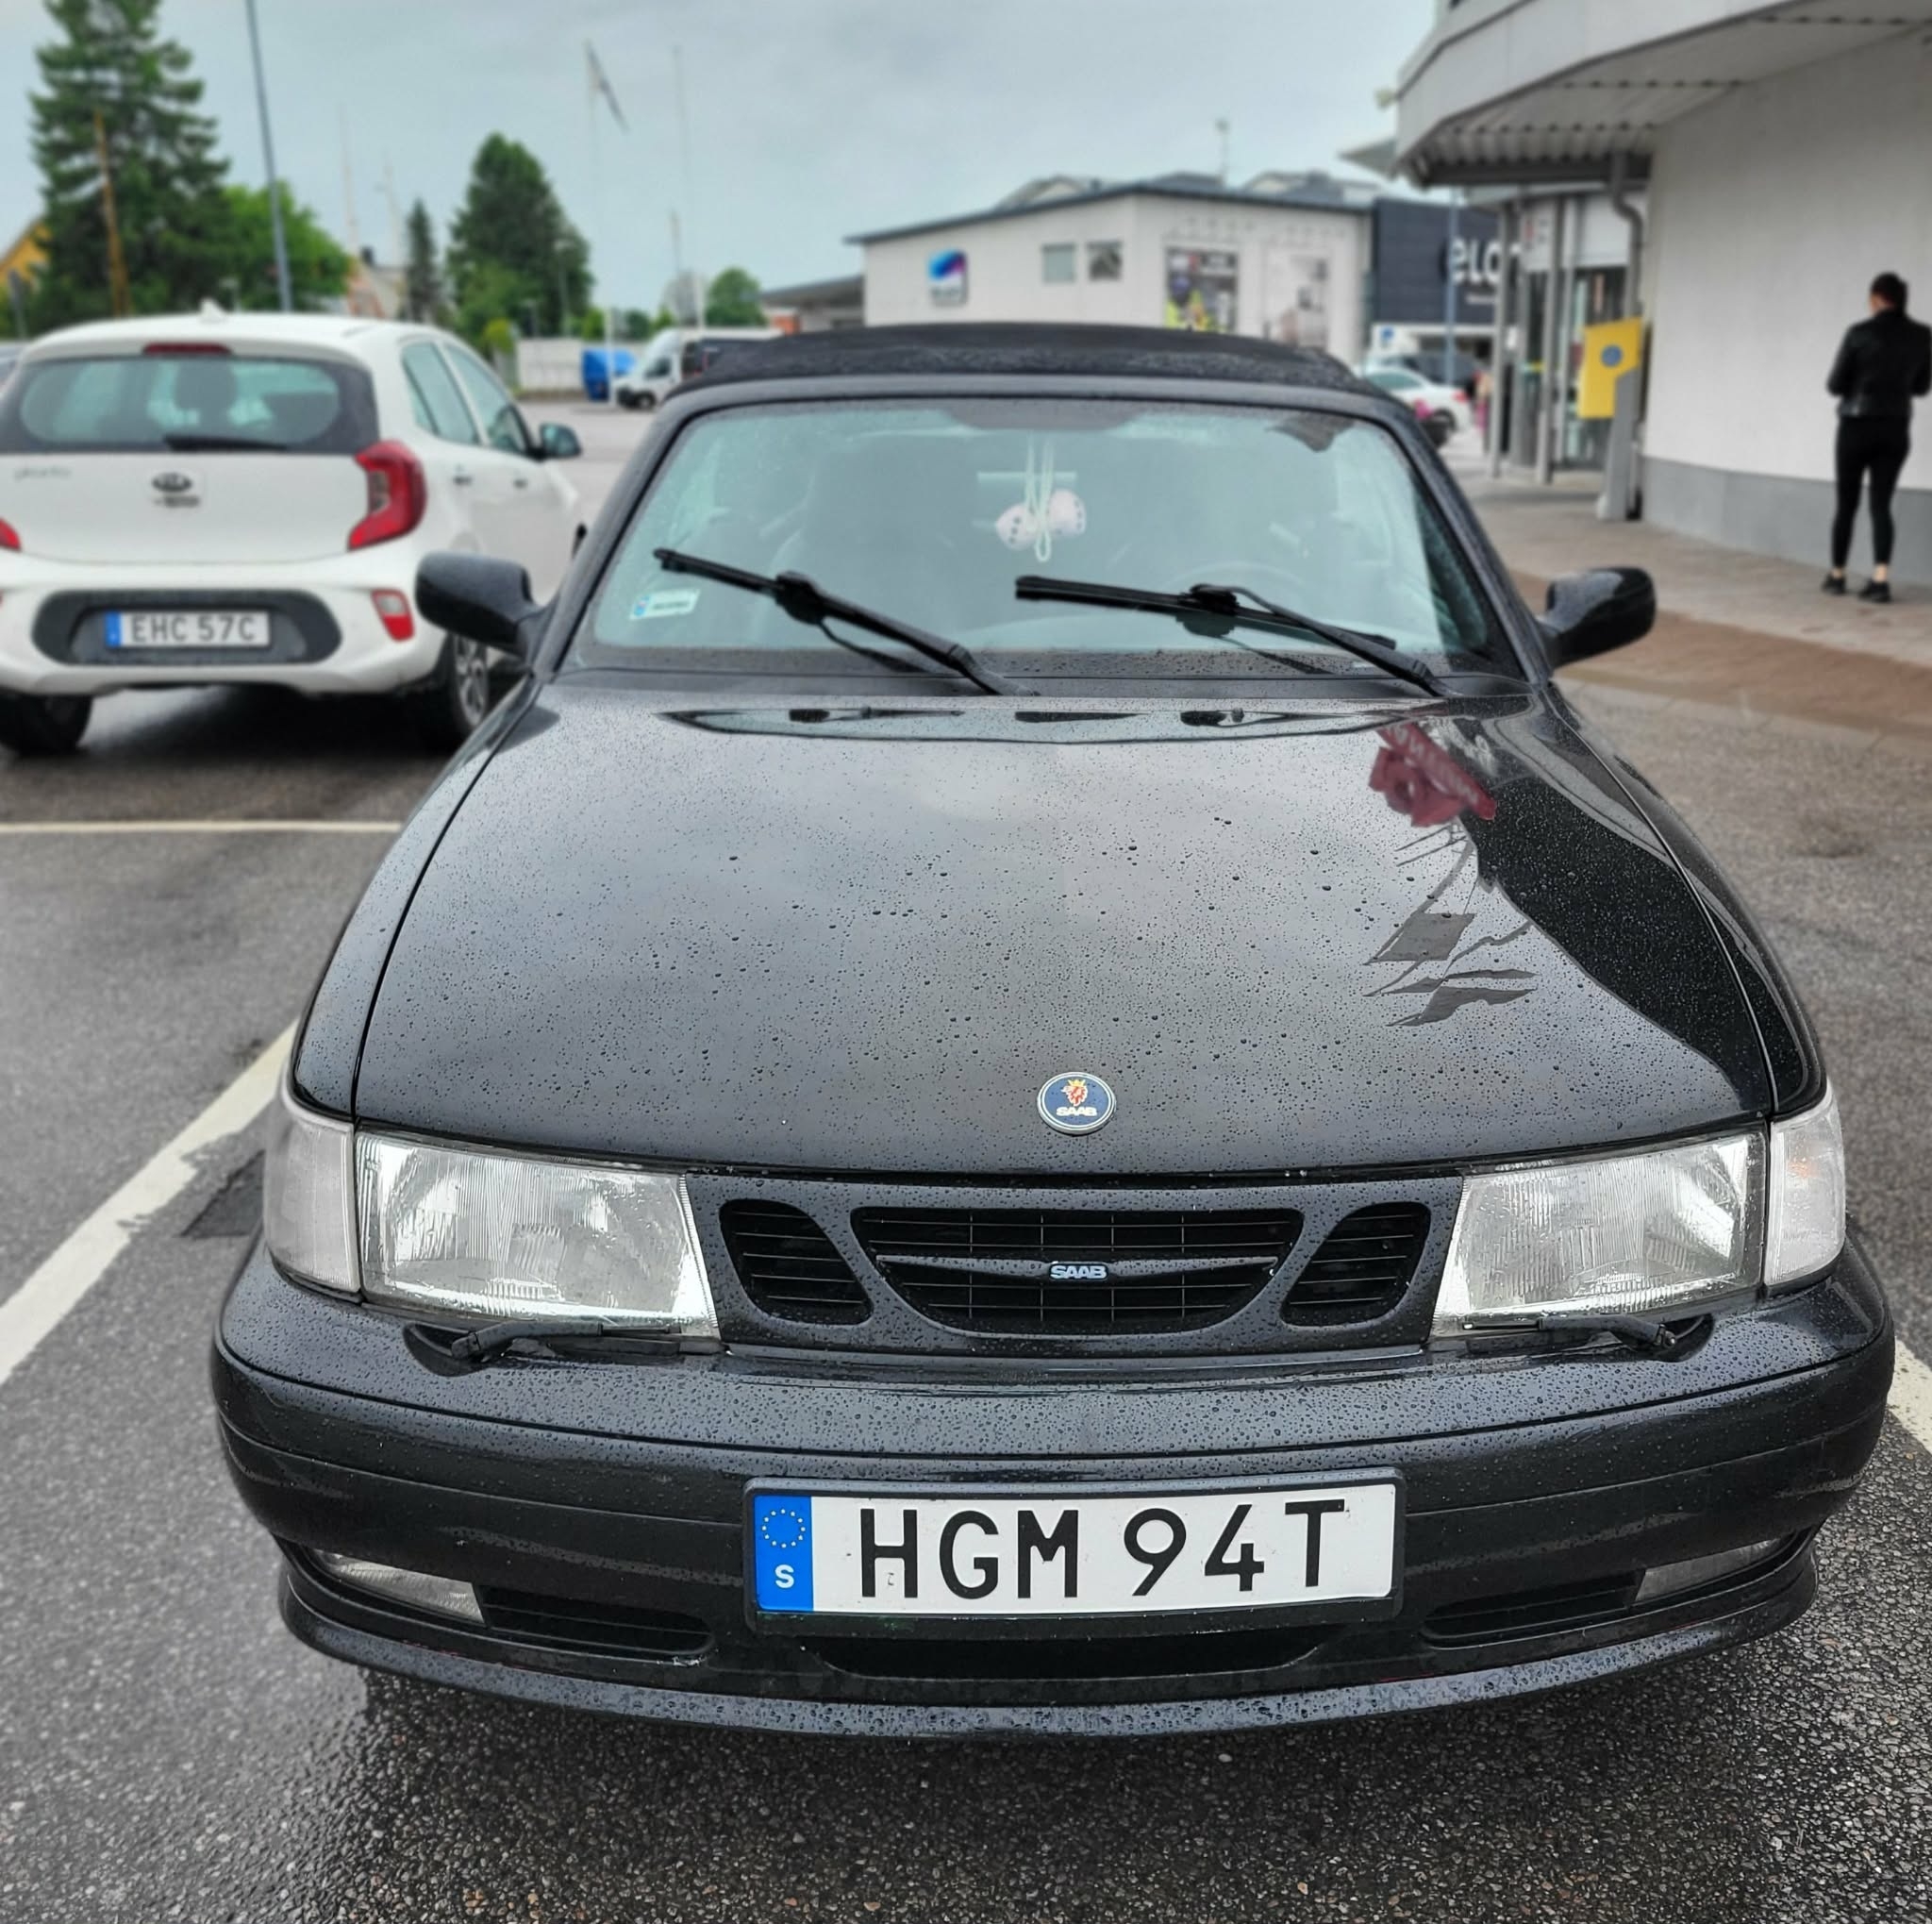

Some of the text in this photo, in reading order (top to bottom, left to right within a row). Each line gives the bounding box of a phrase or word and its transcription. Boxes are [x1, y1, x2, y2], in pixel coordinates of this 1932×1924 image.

[1449, 238, 1521, 283] elo
[131, 615, 256, 643] EHC 57C
[1056, 1106, 1097, 1116] SAAB
[1050, 1265, 1108, 1280] SAAB
[859, 1498, 1346, 1600] HGM 94T
[774, 1564, 795, 1589] S
